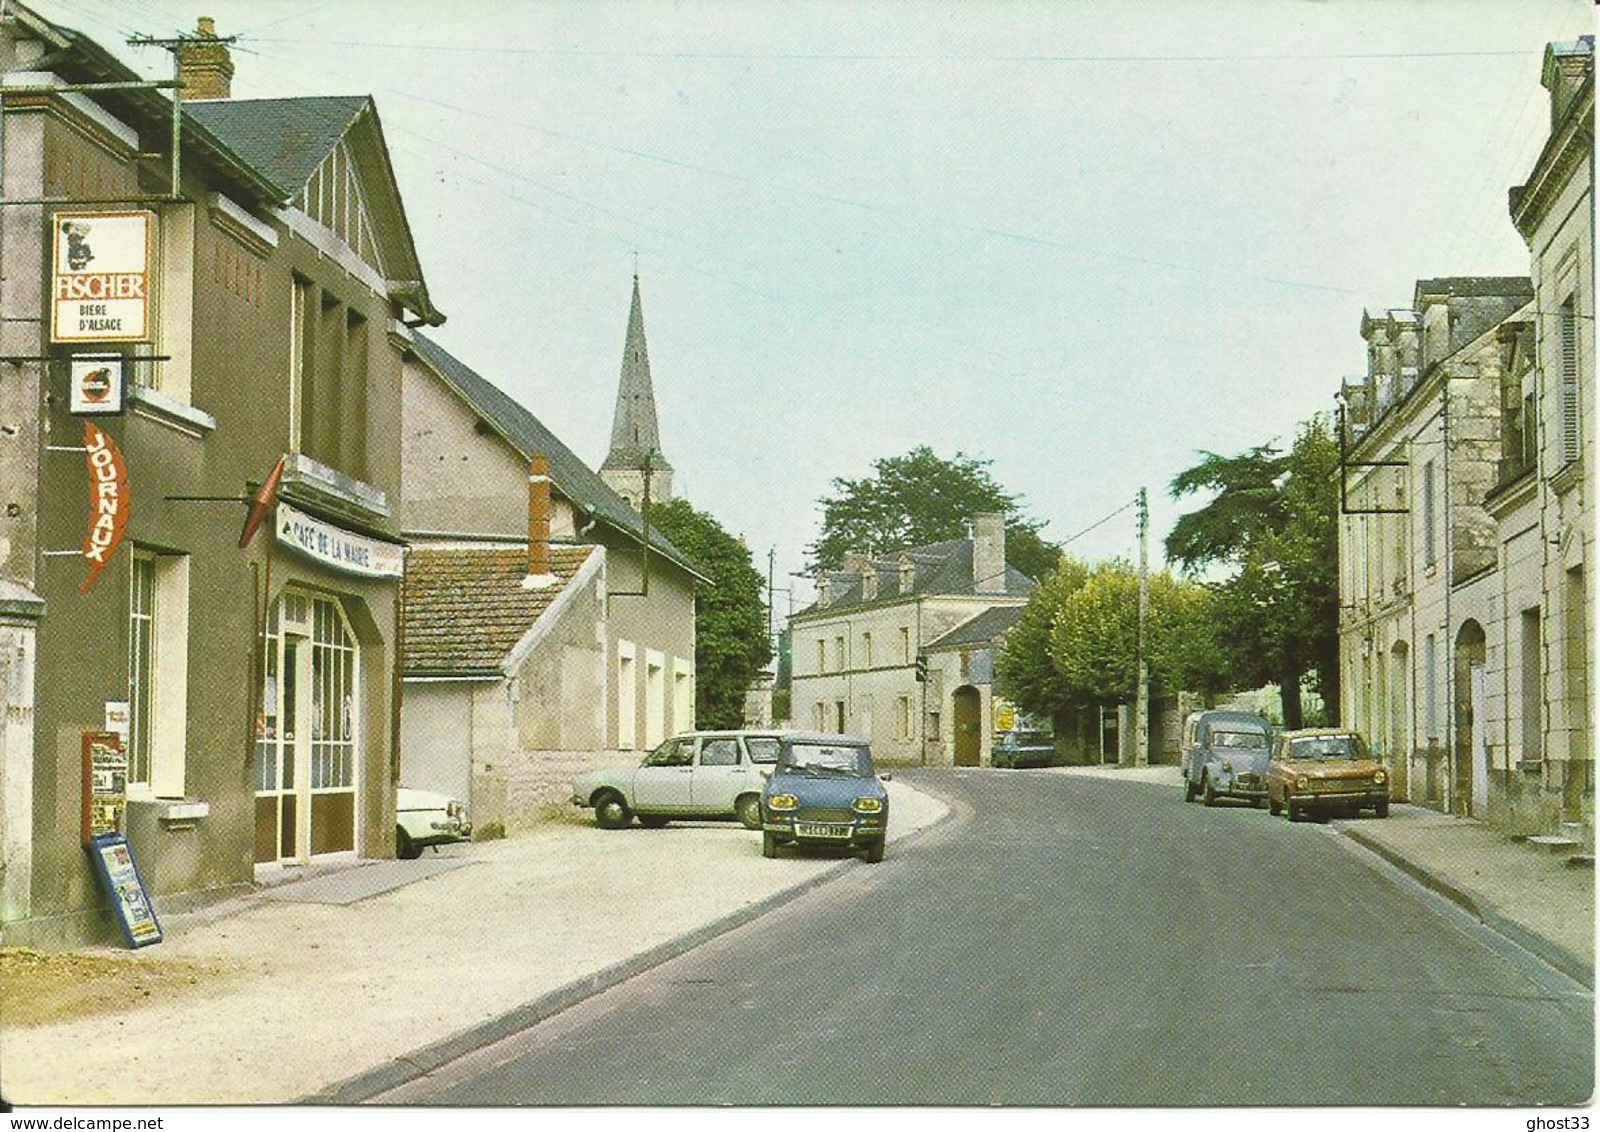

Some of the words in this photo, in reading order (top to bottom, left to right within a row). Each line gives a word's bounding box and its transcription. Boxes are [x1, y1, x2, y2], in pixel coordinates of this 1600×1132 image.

[56, 274, 145, 299] FISCHER
[79, 318, 123, 332] D'ALSACE
[85, 433, 118, 562] JOURNAUX
[318, 531, 328, 556] DE
[332, 537, 342, 561] LA
